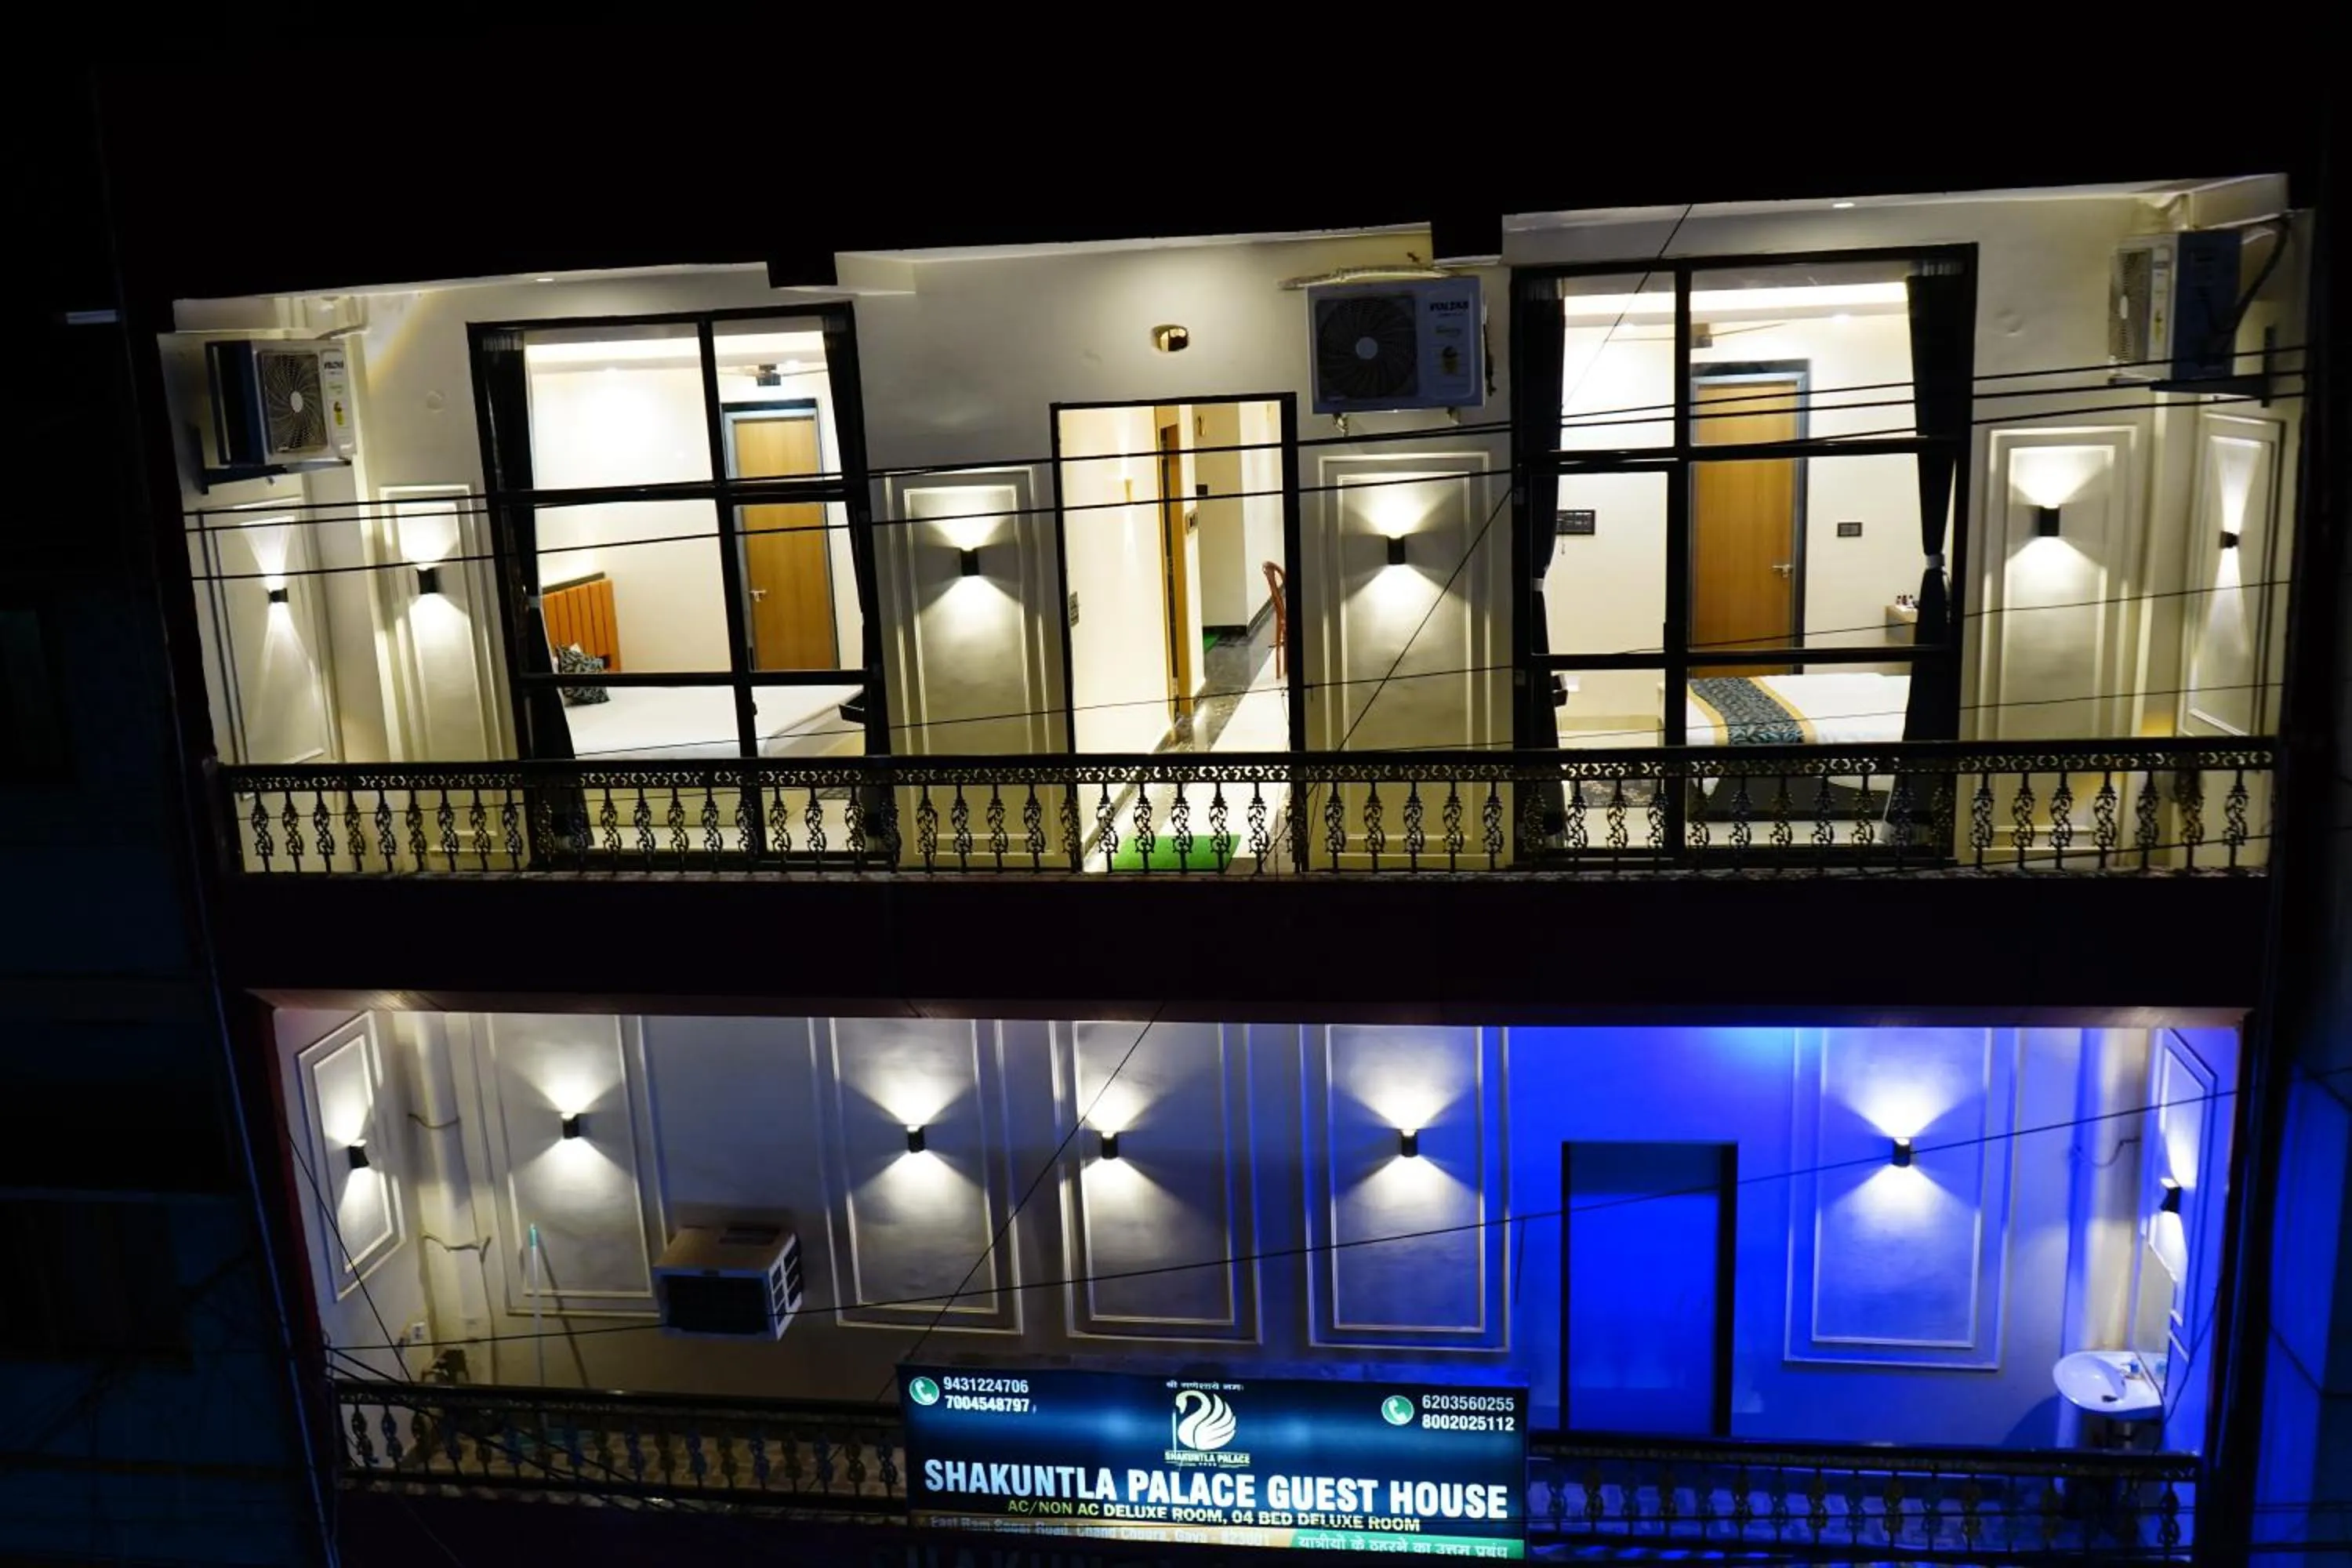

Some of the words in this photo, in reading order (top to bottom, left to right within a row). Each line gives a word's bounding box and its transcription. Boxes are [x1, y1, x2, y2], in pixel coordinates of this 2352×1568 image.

[943, 1376, 1029, 1393] 9431224706
[944, 1395, 1029, 1412] 7004548797
[1421, 1395, 1515, 1411] 6203560255
[1421, 1414, 1515, 1431] 8002025112
[1218, 1454, 1250, 1464] PALACE
[924, 1459, 1118, 1501] SHAKUNTLA
[1127, 1468, 1256, 1508] PALACE
[1267, 1475, 1378, 1513] GUEST
[1390, 1479, 1508, 1519] HOUSE
[1007, 1500, 1073, 1517] AC/NON
[1077, 1503, 1100, 1515] AC
[1103, 1504, 1167, 1519] DELUXE
[1172, 1508, 1228, 1524] ROOM,
[1232, 1510, 1254, 1524] 04
[1258, 1511, 1293, 1526] BED
[1298, 1513, 1364, 1529] DELUXE
[1368, 1516, 1421, 1532] ROOM
[1412, 1542, 1432, 1553] का
